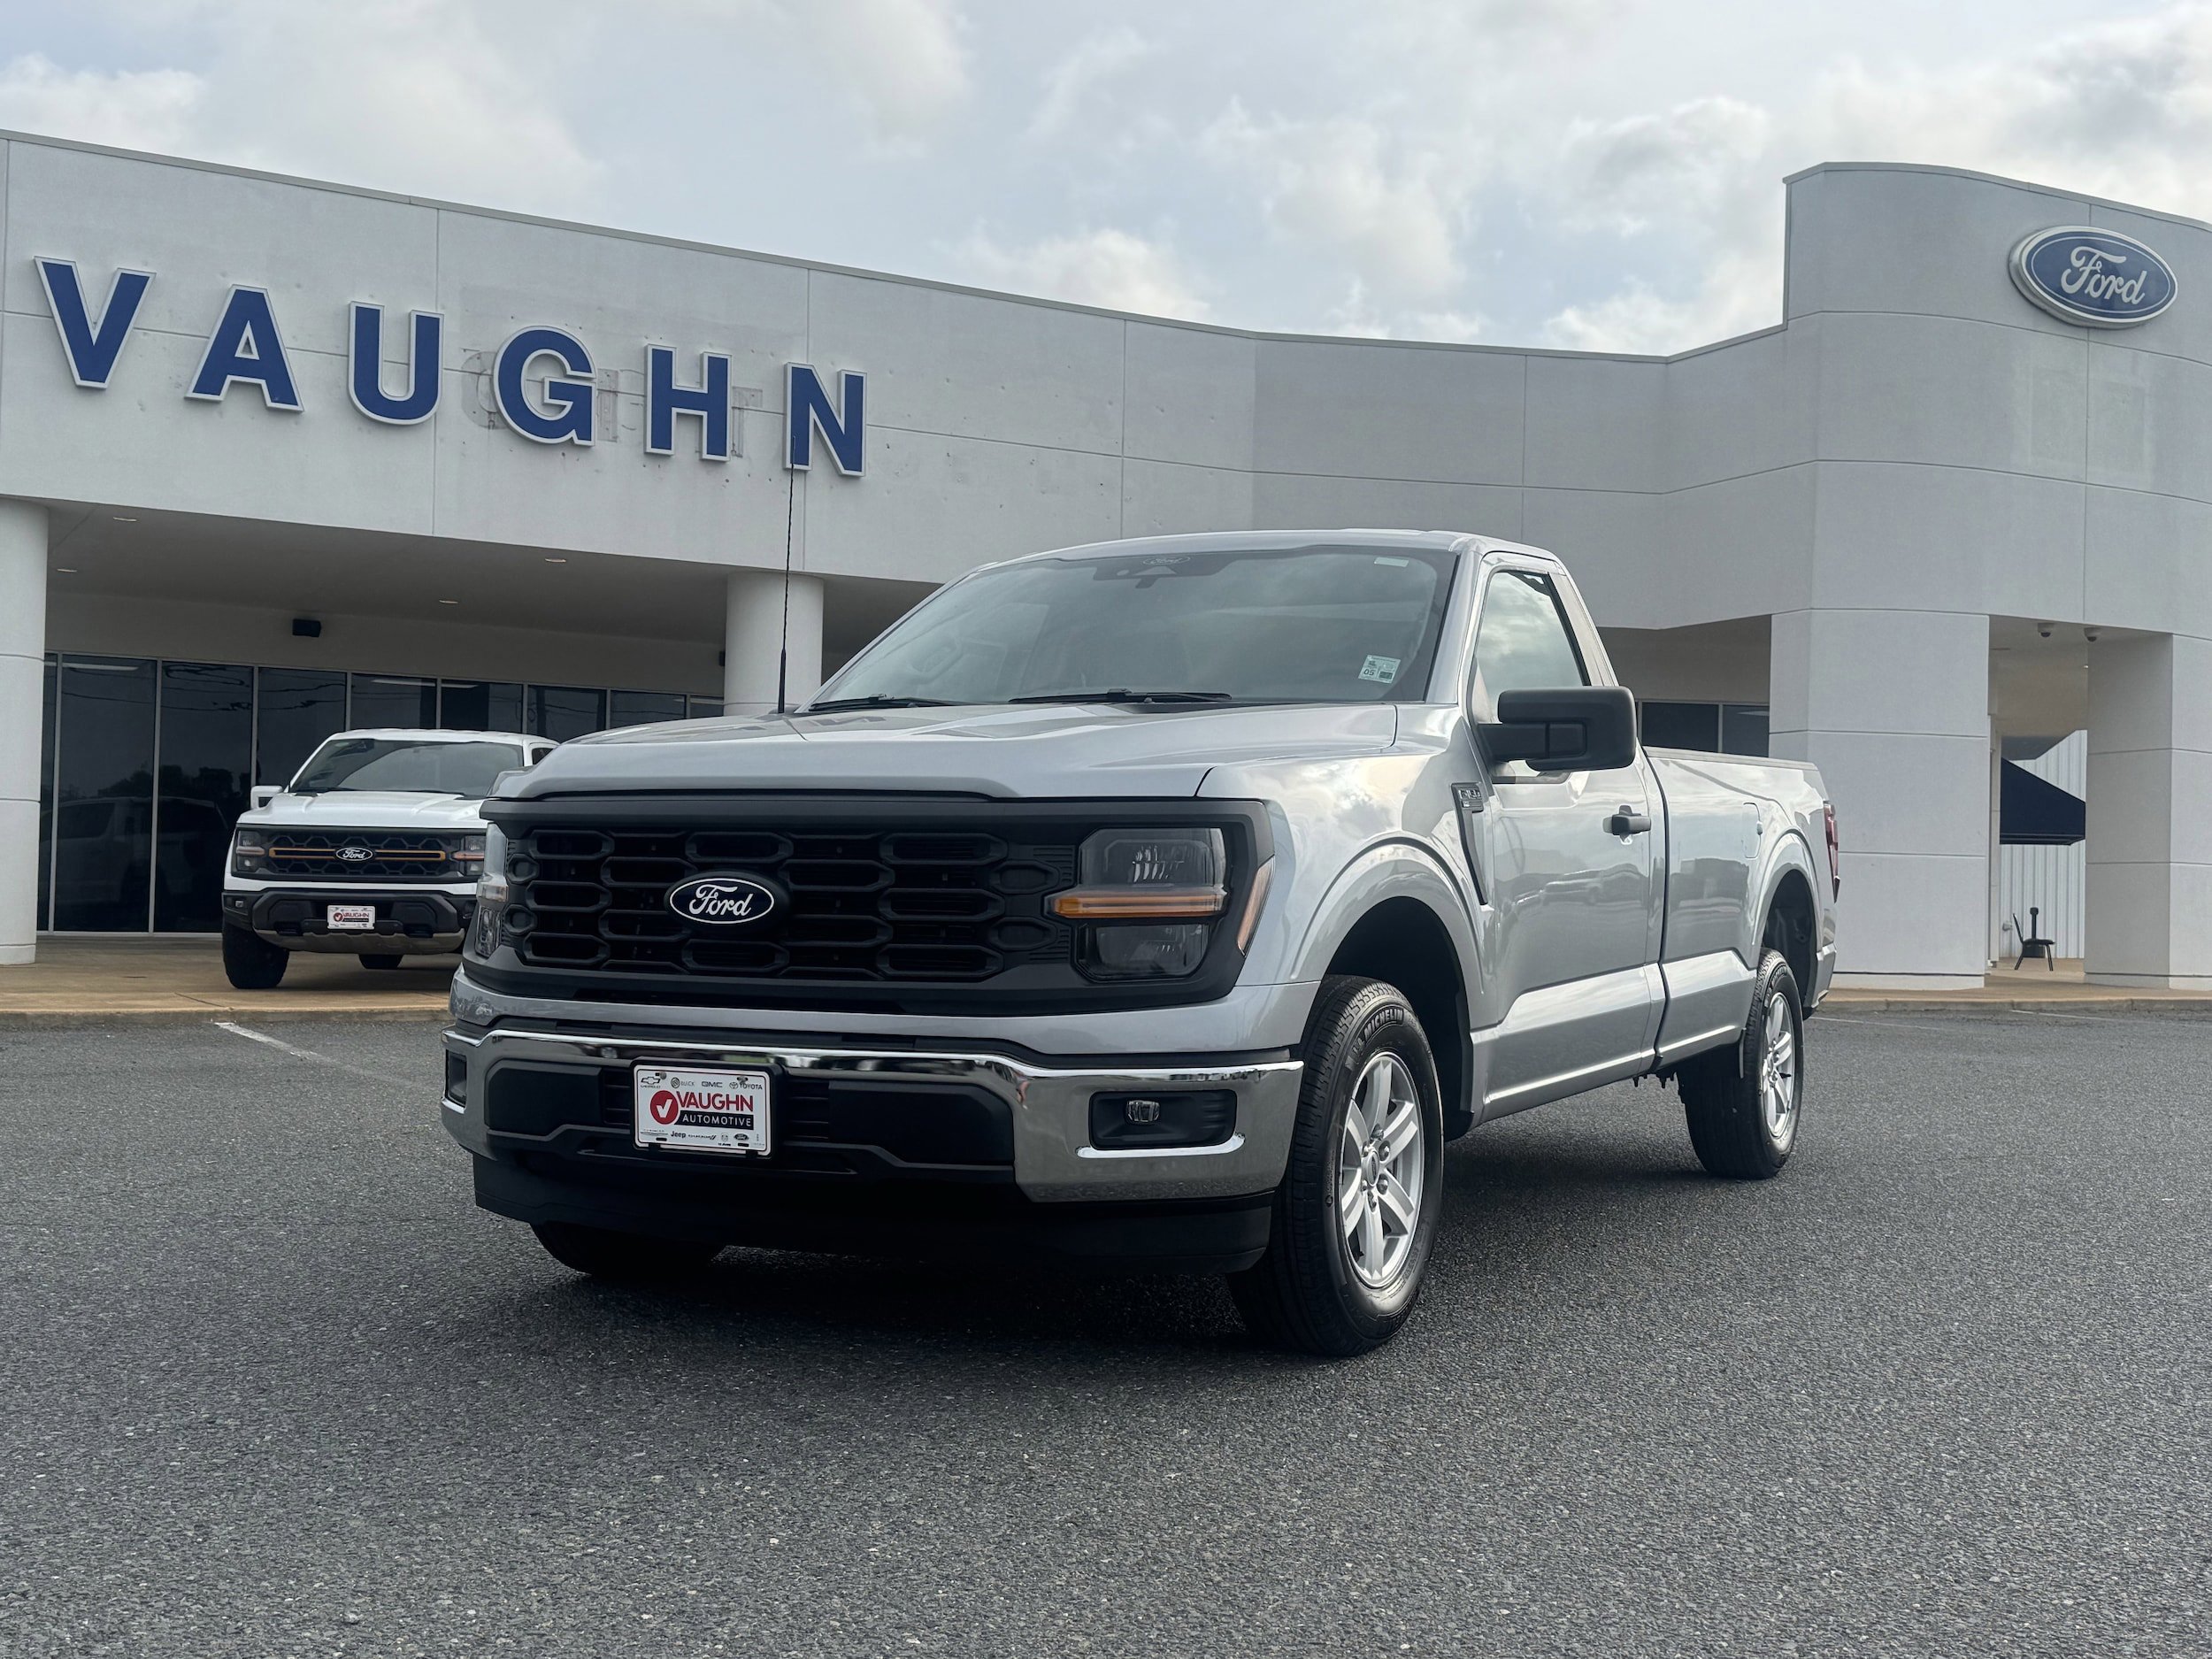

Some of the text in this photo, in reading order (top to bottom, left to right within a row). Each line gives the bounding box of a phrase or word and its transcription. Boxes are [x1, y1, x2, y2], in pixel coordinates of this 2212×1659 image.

[2060, 245, 2148, 305] Ford
[33, 255, 868, 478] VAUGHN
[342, 849, 365, 858] Ford
[688, 884, 754, 917] Ford
[1363, 1008, 1403, 1041] MICHELIN
[675, 1090, 754, 1112] VAUGHN
[681, 1113, 752, 1127] AUTOMOTIVE
